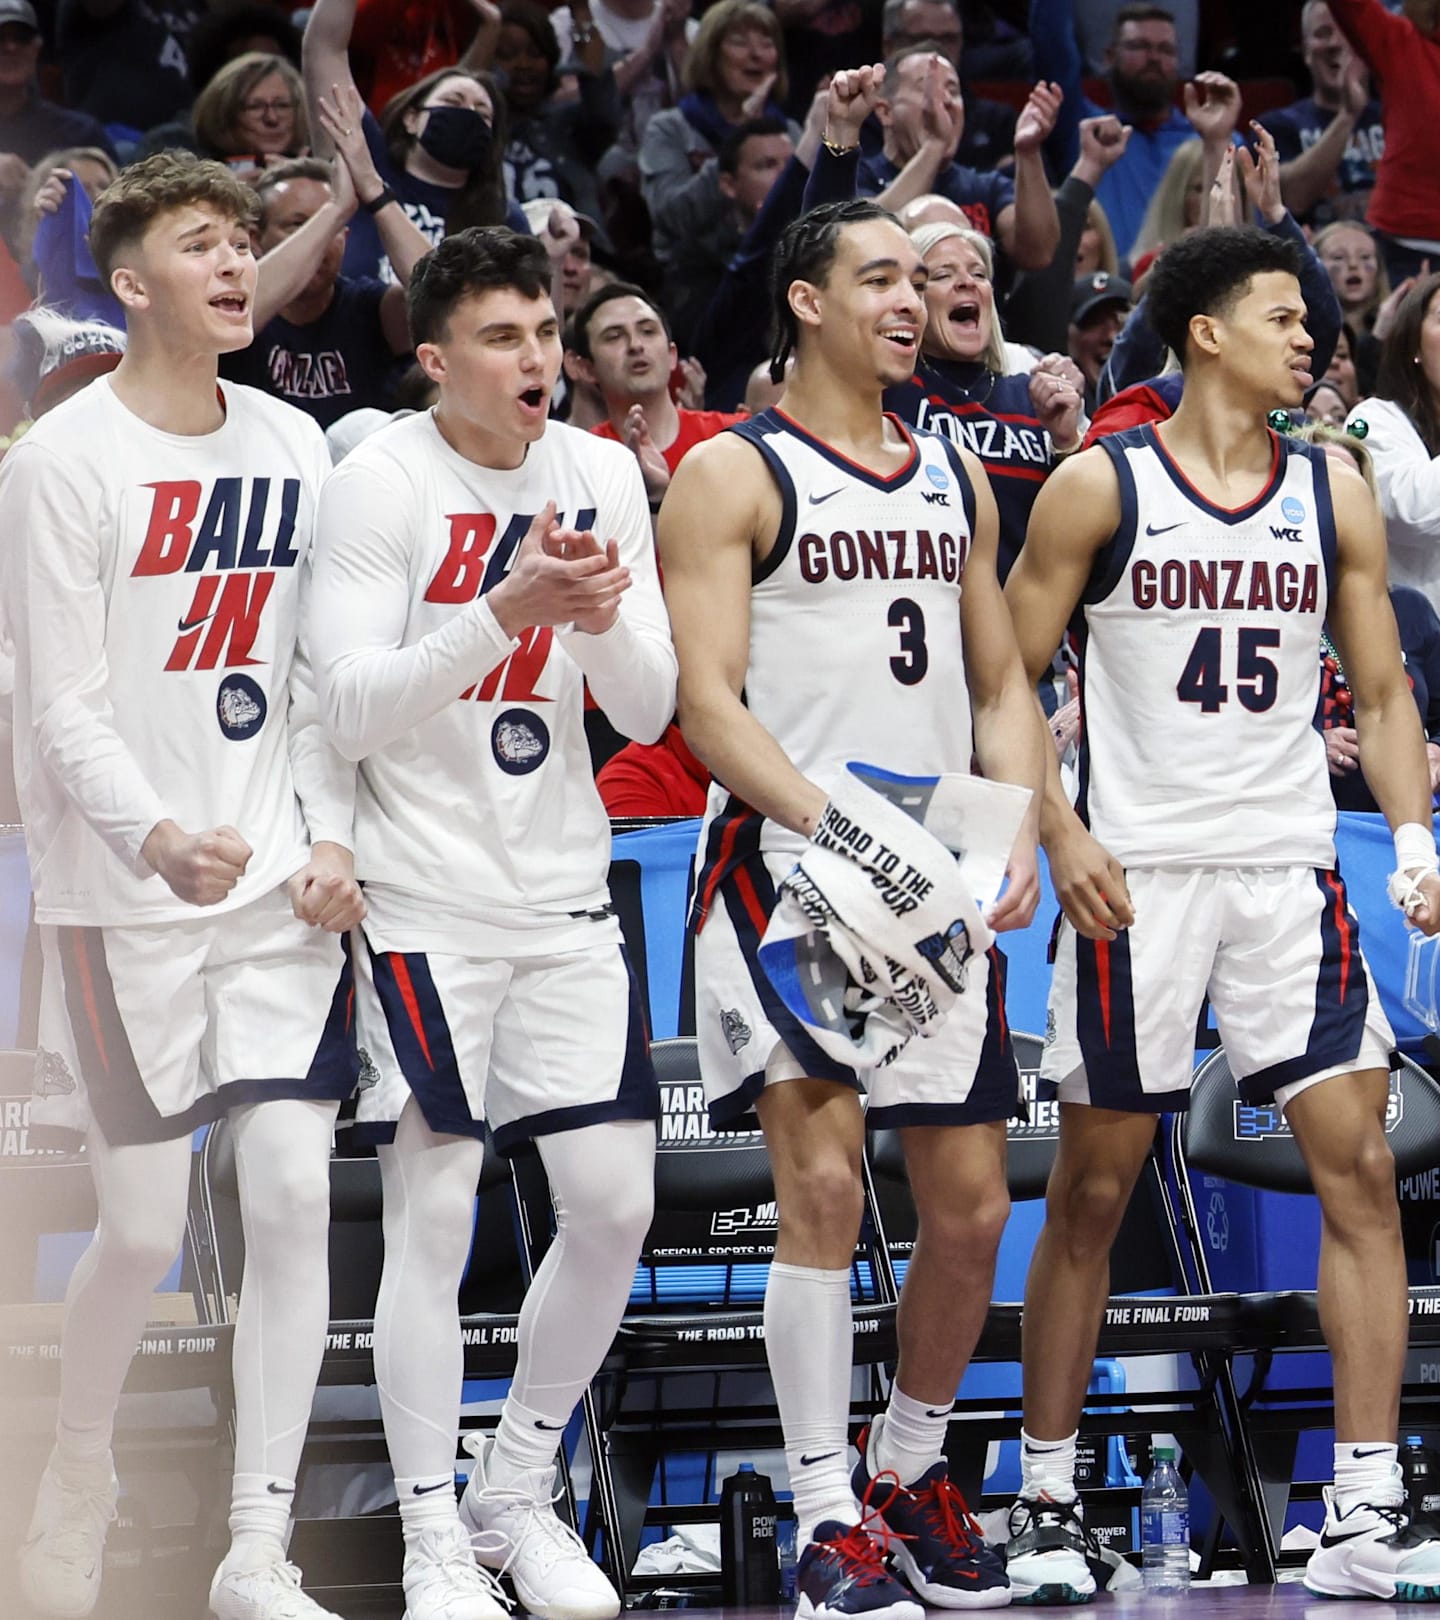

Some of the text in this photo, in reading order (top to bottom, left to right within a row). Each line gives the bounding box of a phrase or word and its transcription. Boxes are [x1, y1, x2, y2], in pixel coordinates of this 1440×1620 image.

[916, 398, 1052, 465] GONZAG
[130, 477, 300, 577] BALL
[1132, 559, 1318, 614] GONZAGA
[163, 572, 275, 671] IN
[888, 597, 928, 686] 3
[1176, 627, 1281, 713] 45
[825, 807, 873, 853] ROAD
[871, 844, 900, 874] TO
[899, 864, 935, 902] THE
[677, 1326, 765, 1341] THE ROAD TO
[1106, 1306, 1210, 1324] THE FINAL FOUR
[1417, 1298, 1440, 1314] THE
[178, 1337, 216, 1353] FOUR
[326, 1335, 351, 1350] THE
